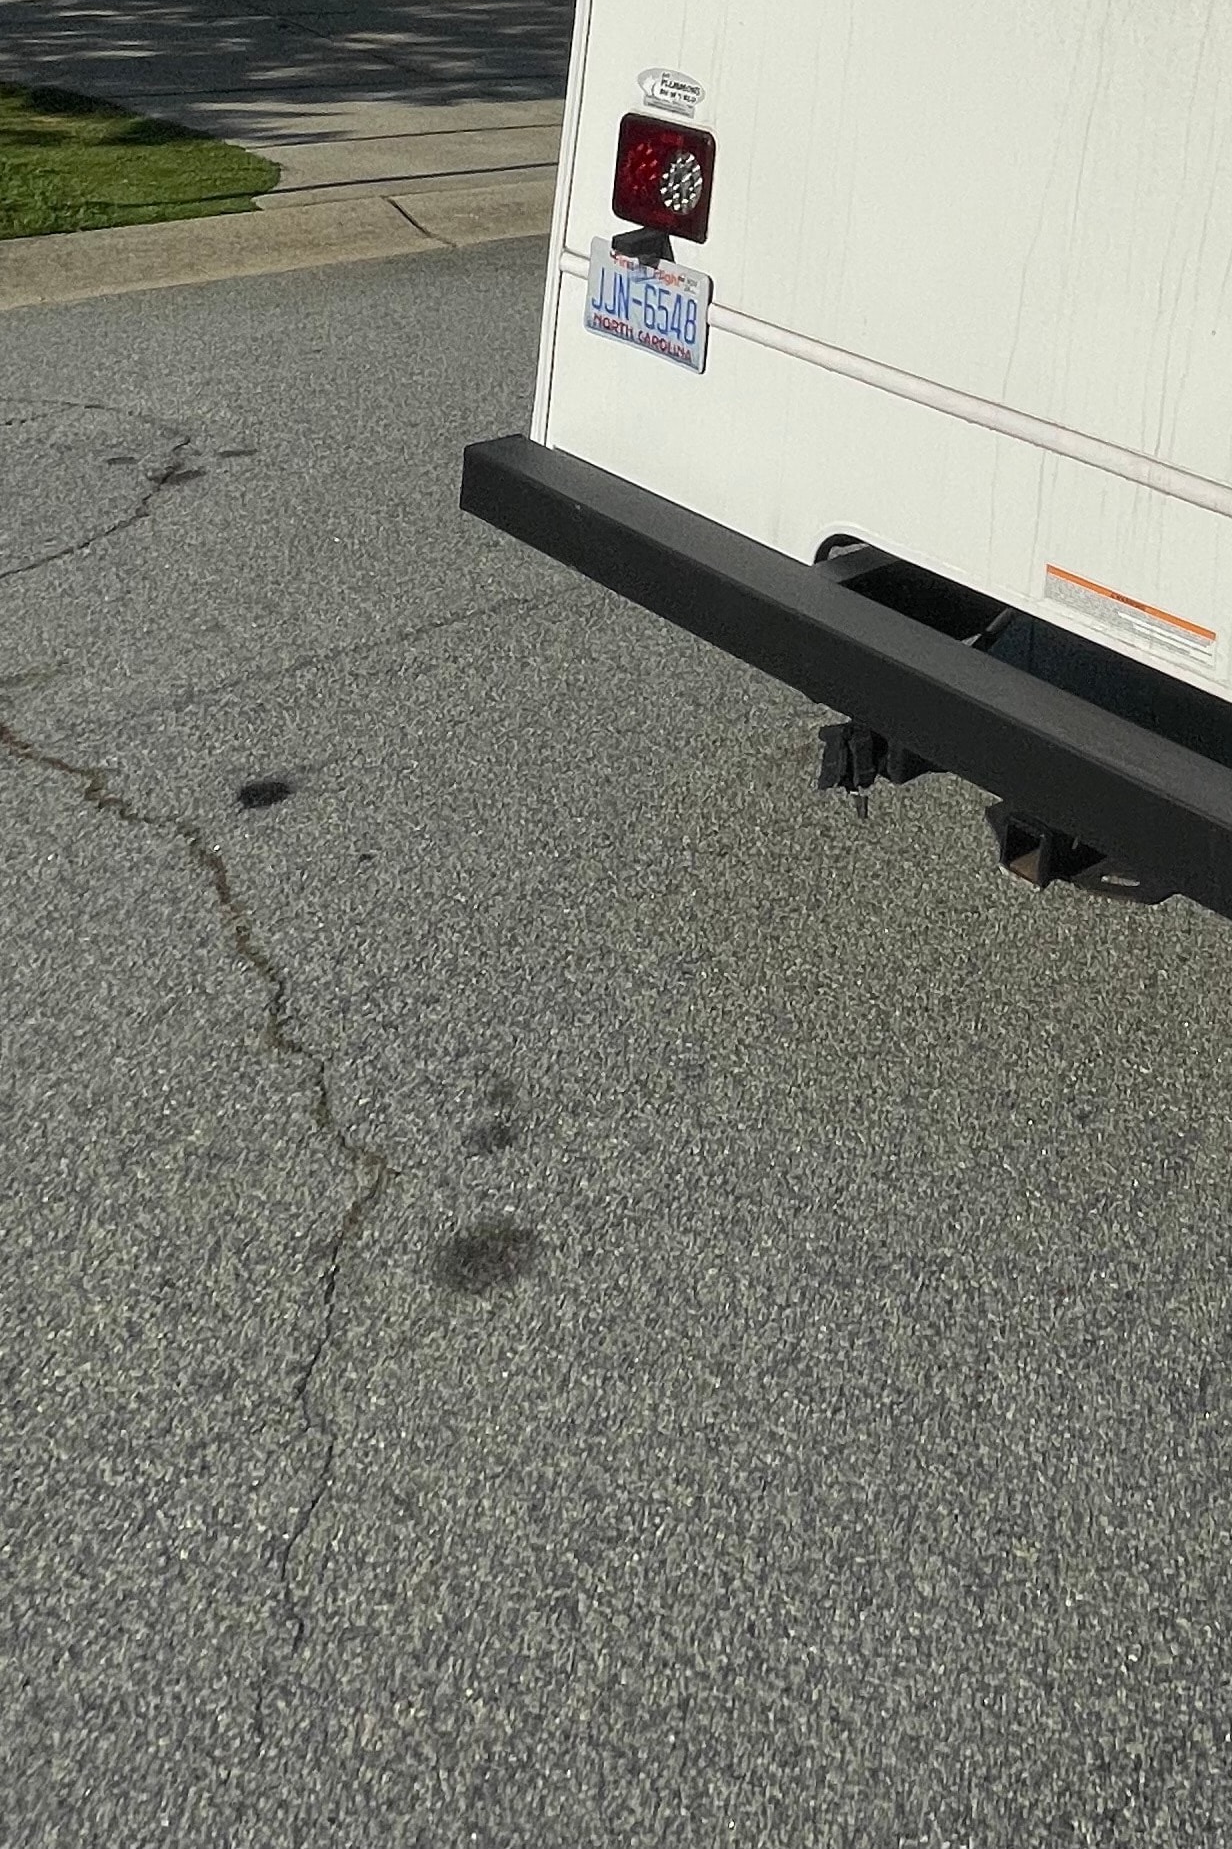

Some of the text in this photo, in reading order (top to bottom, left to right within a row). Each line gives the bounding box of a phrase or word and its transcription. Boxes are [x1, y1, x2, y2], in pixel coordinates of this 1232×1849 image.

[591, 266, 698, 345] JJN-6548
[592, 312, 692, 362] NORTH CAROLINA
